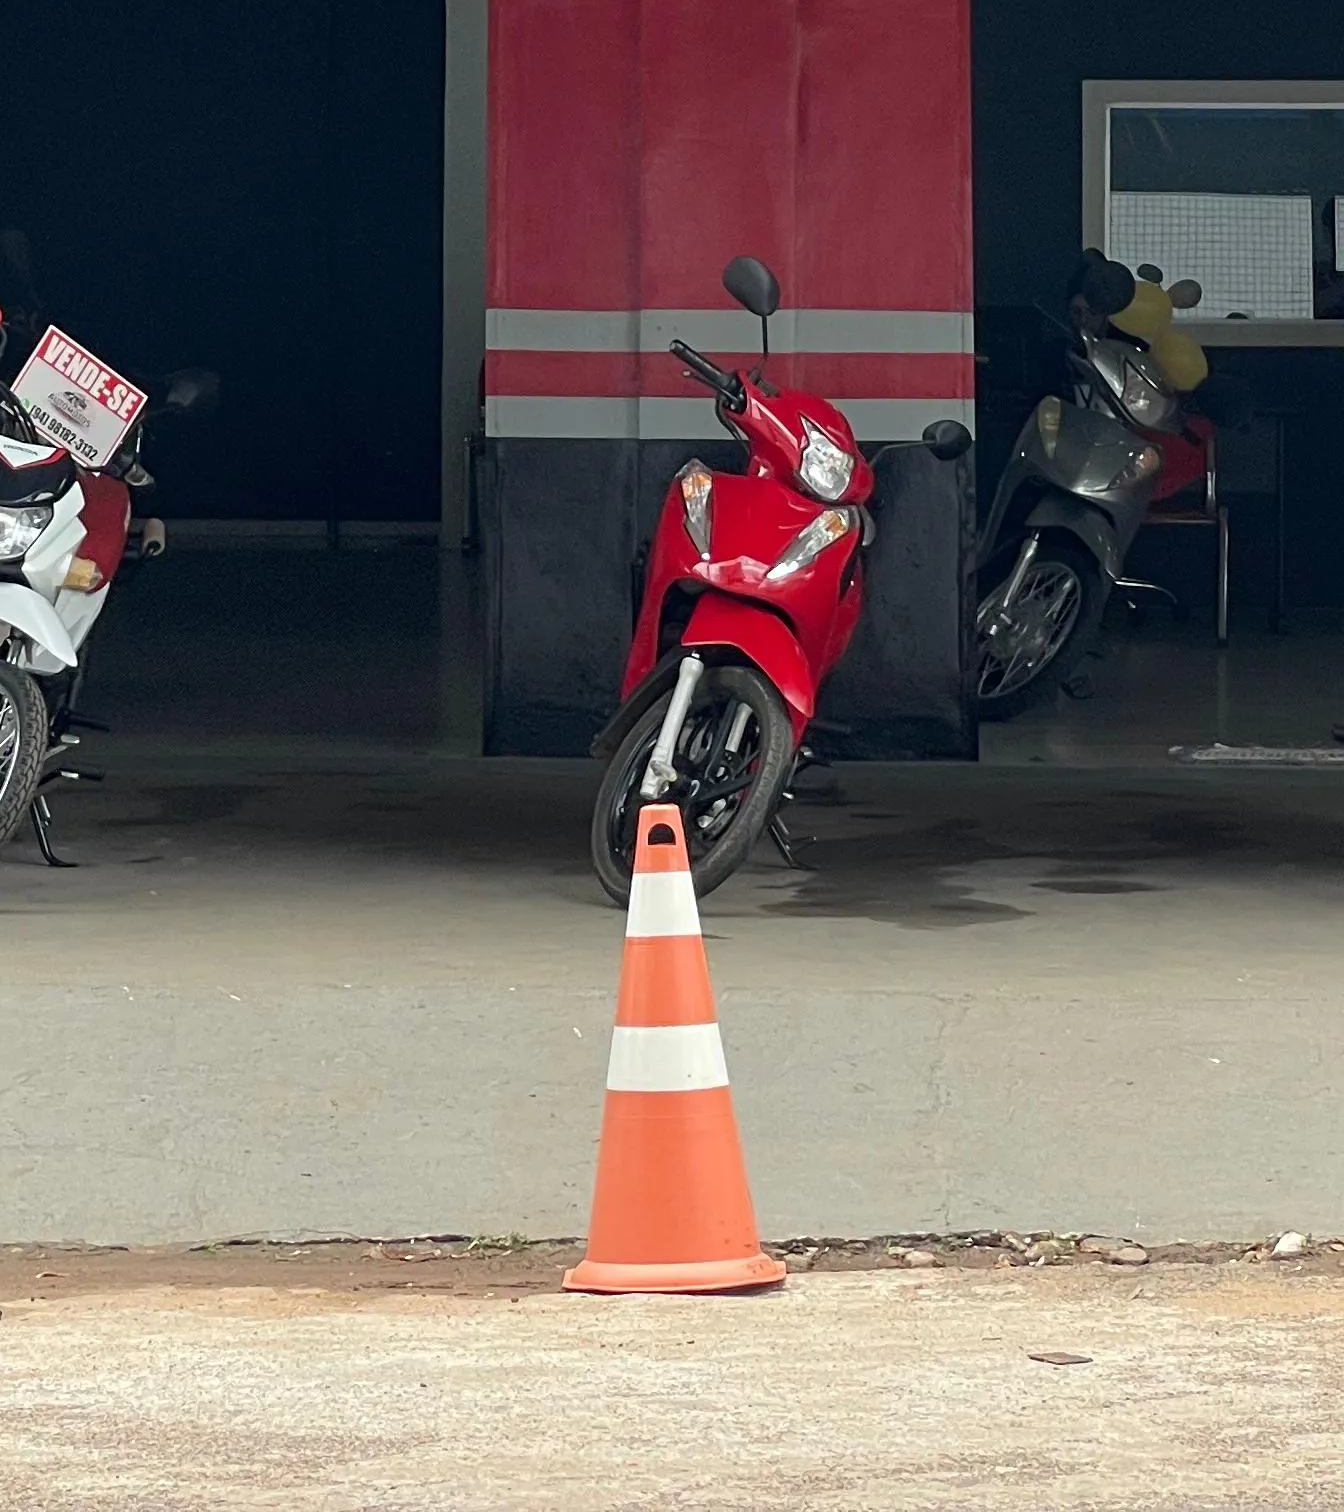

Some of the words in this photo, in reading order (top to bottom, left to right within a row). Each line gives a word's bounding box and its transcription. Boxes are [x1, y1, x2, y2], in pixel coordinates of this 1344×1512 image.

[43, 334, 139, 419] VENDE-SE
[29, 404, 50, 426] (94)
[47, 418, 98, 462] 98182-3132
